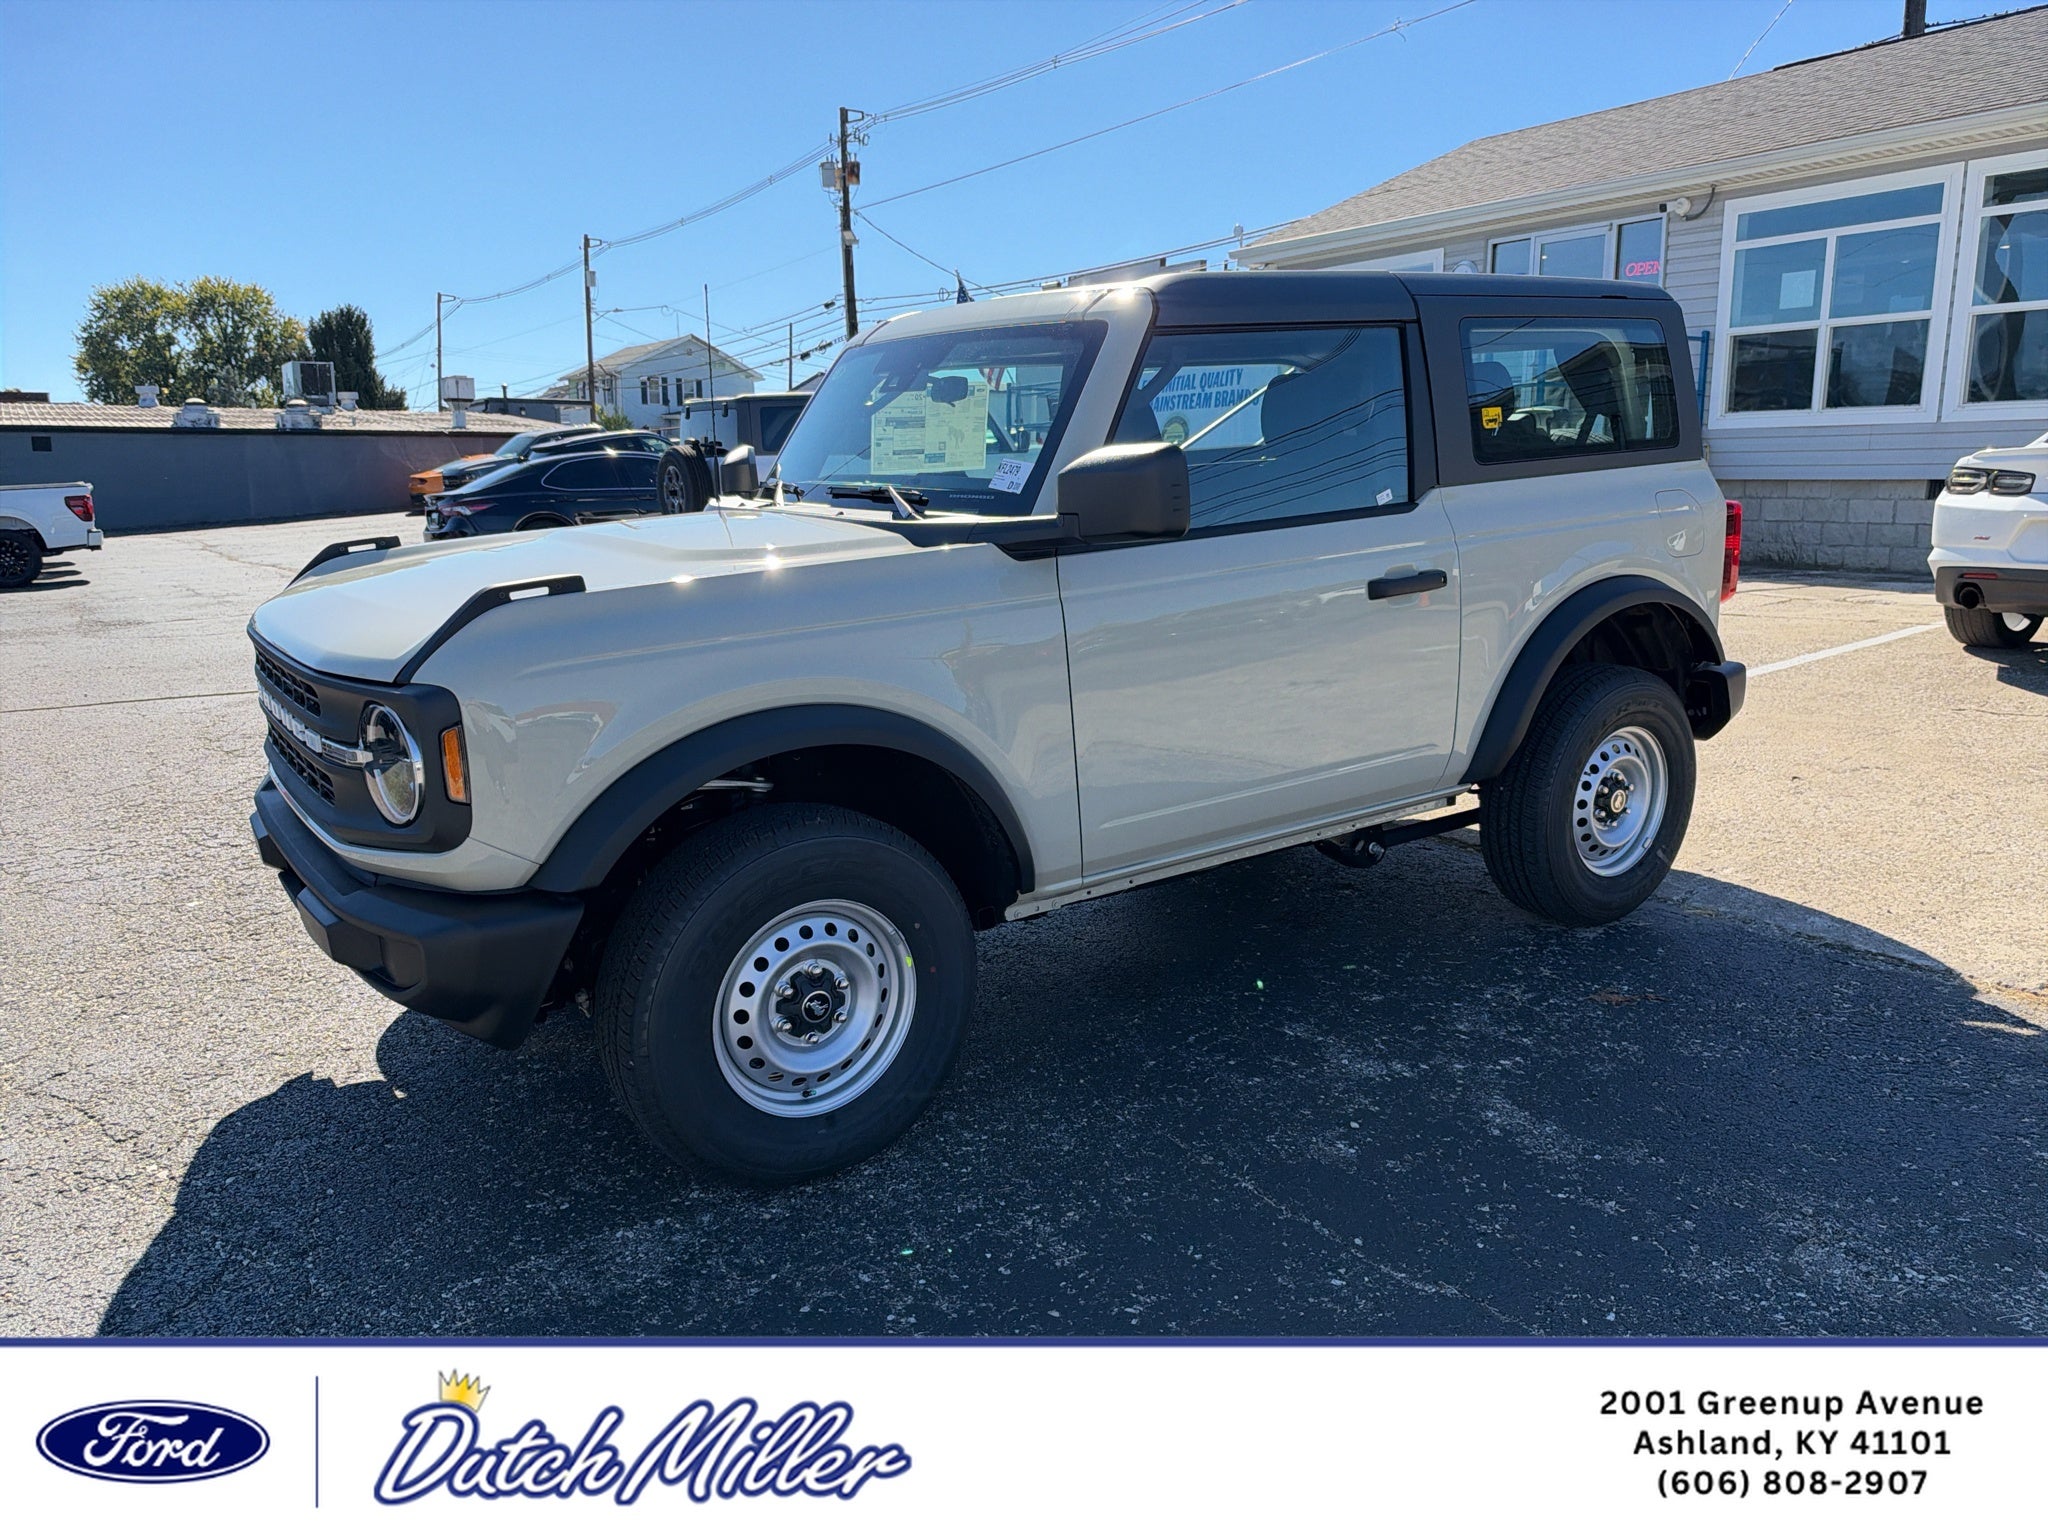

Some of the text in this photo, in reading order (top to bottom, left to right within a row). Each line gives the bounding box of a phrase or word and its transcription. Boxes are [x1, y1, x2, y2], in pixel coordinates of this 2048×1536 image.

[1162, 368, 1244, 393] NITIAL QUALITY
[1151, 391, 1213, 413] AINSTREAM
